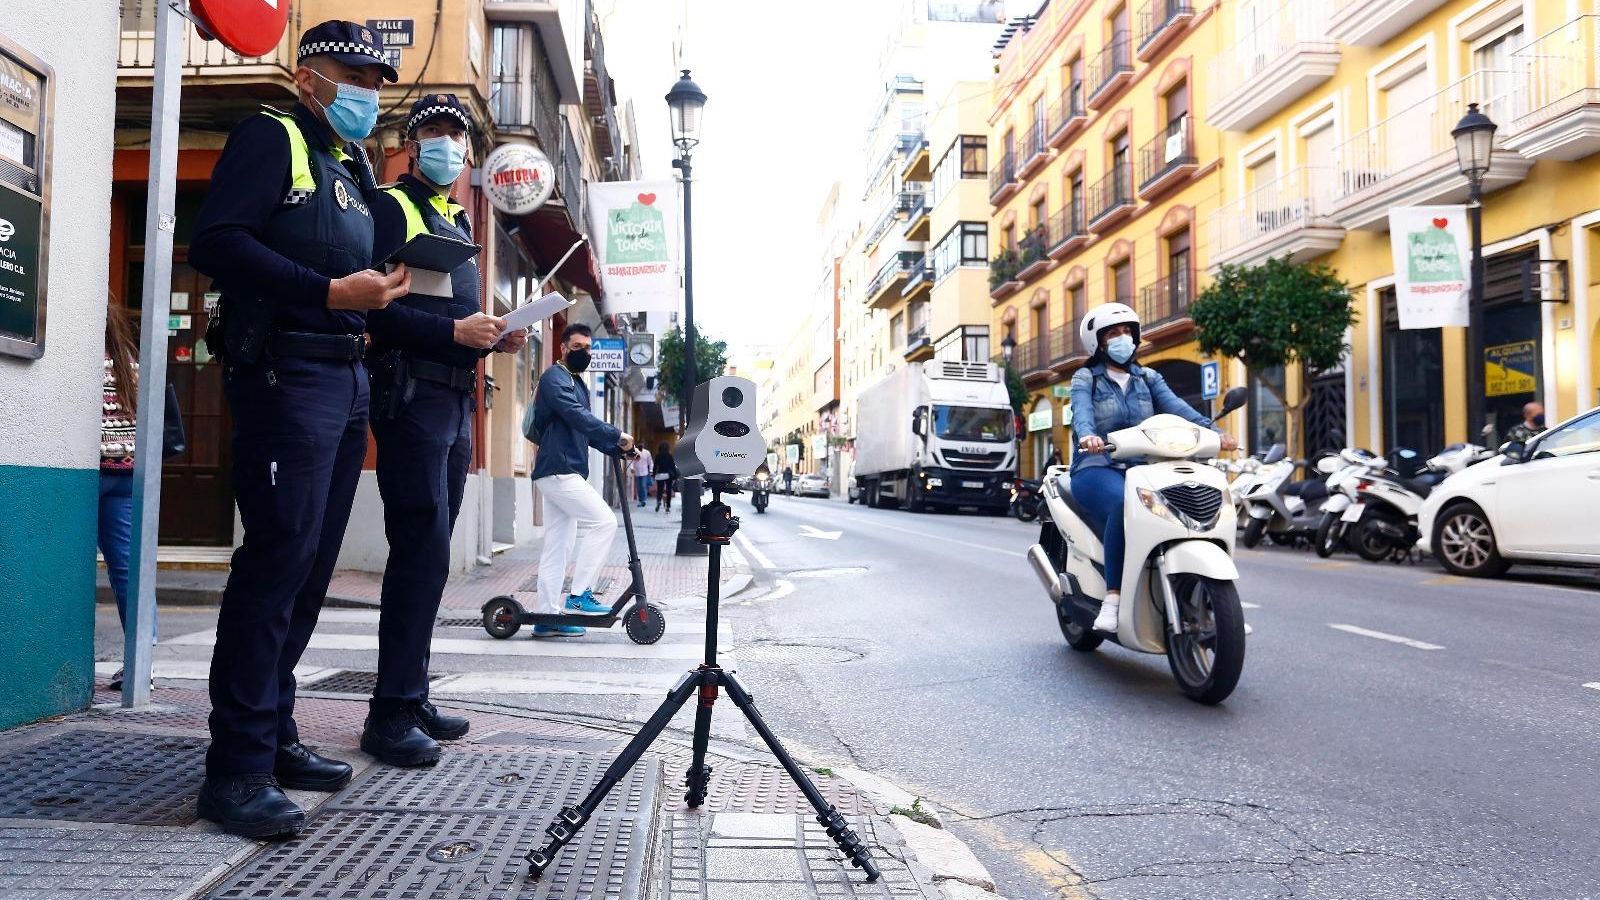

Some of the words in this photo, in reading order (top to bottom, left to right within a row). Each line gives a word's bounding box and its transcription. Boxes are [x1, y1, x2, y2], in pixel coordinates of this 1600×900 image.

[377, 21, 402, 30] CALLE
[493, 168, 540, 186] VICTORIA
[961, 446, 987, 454] IVECO
